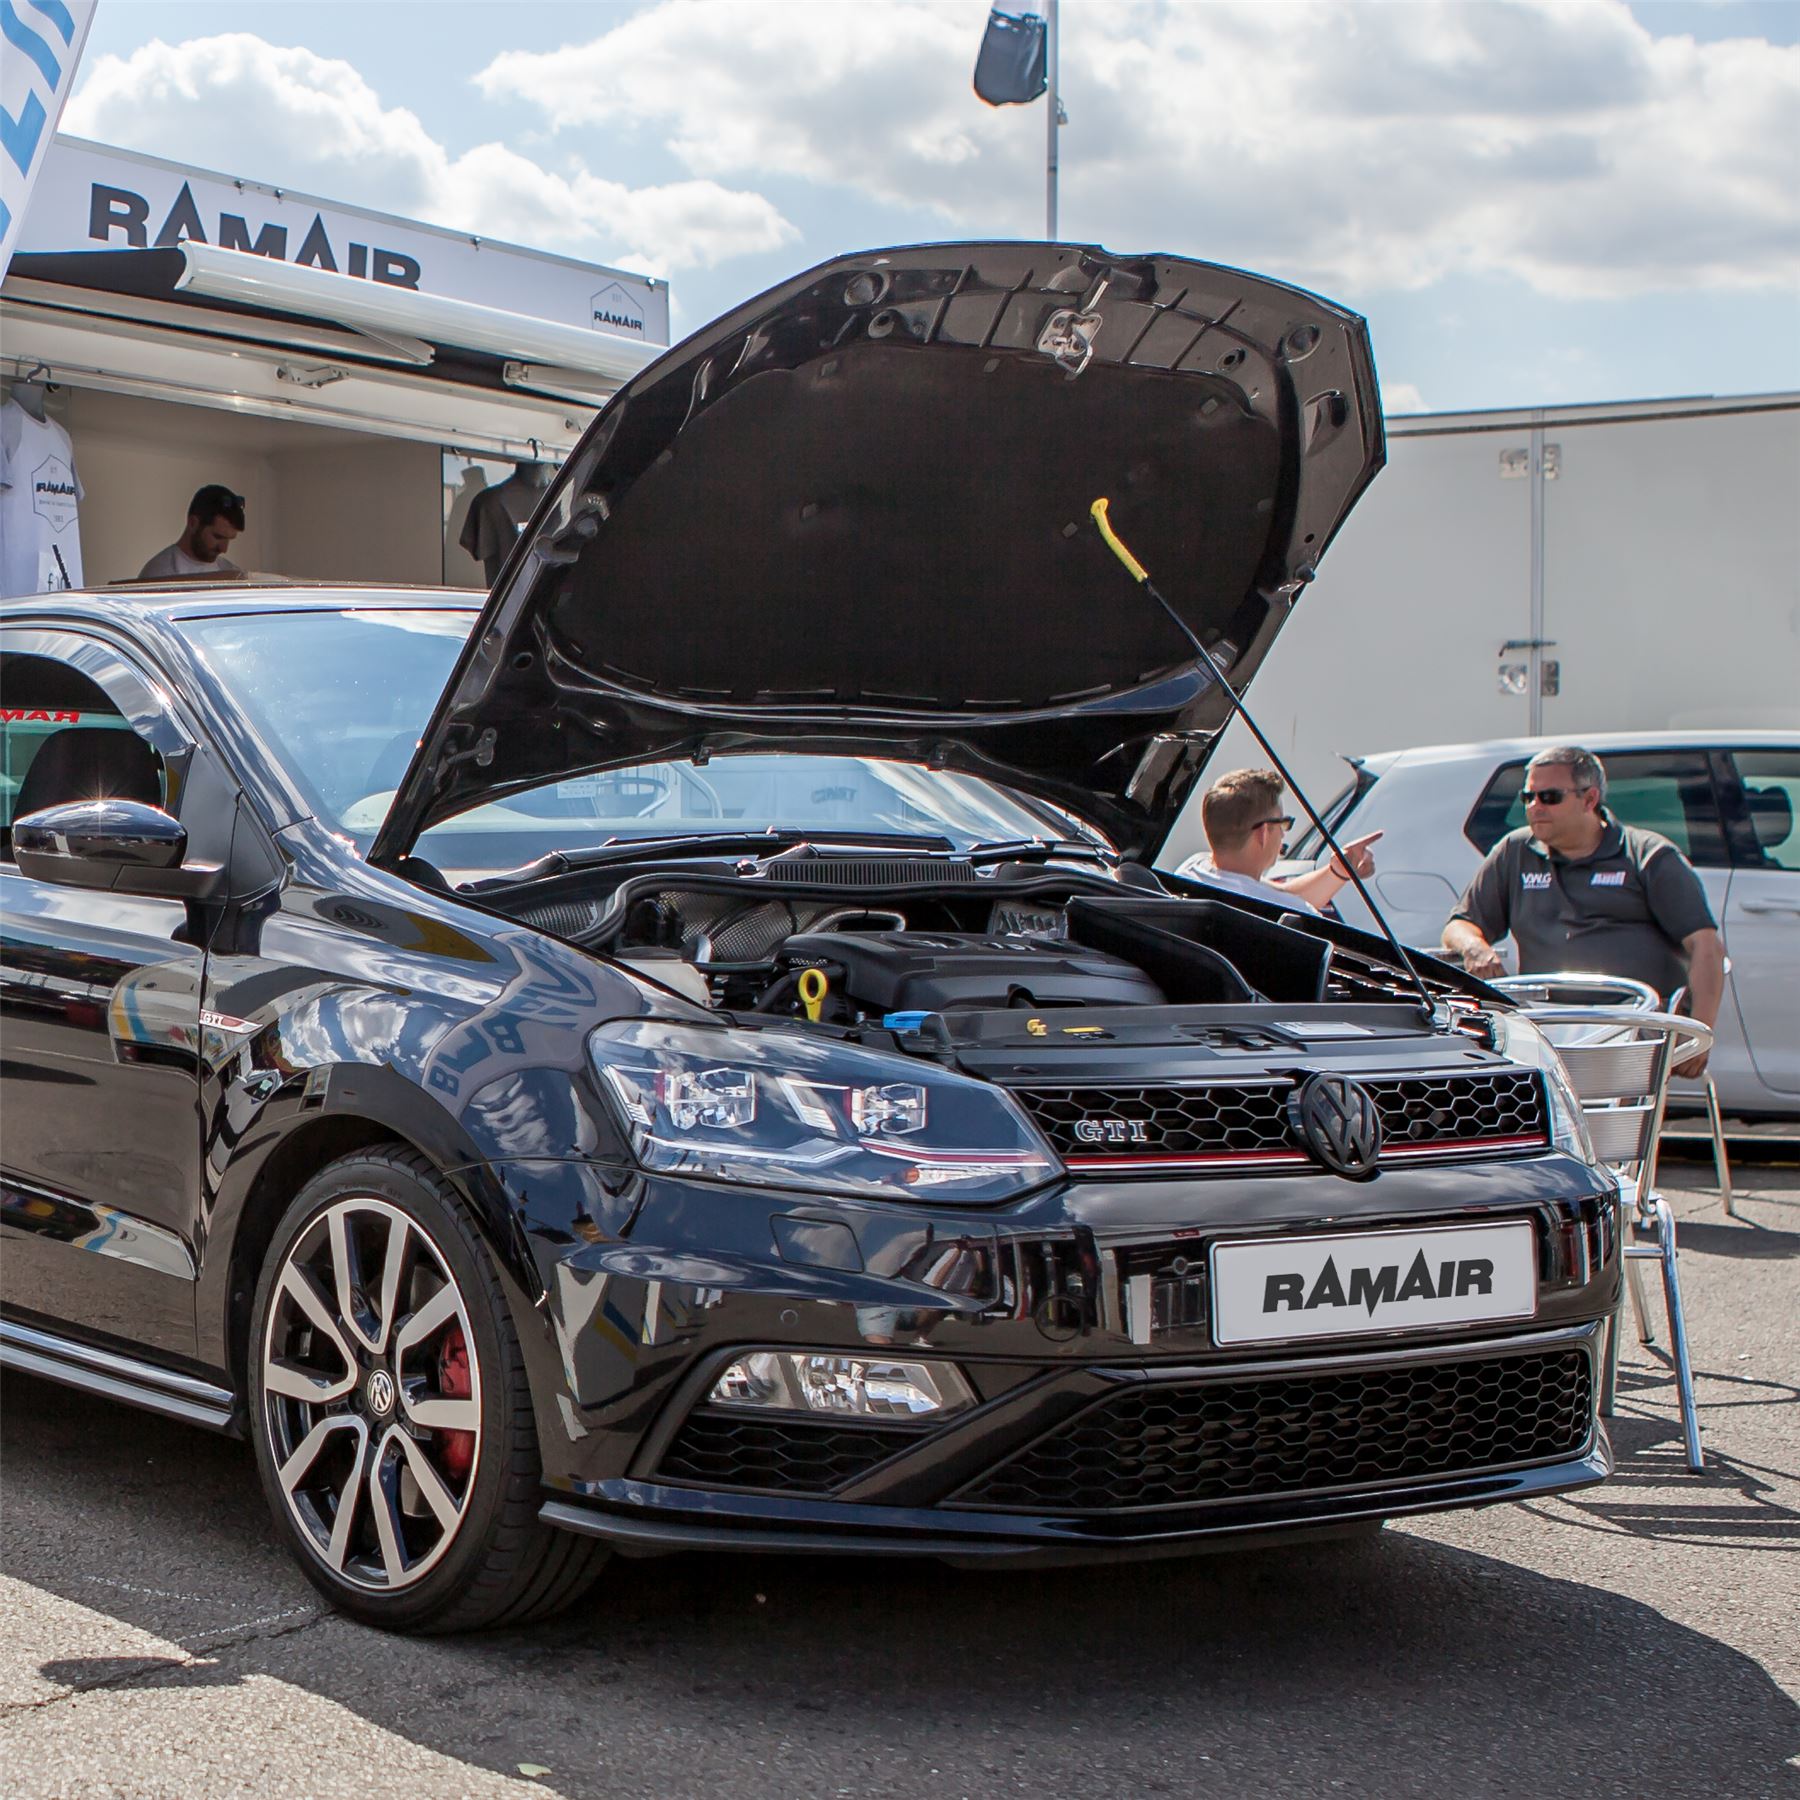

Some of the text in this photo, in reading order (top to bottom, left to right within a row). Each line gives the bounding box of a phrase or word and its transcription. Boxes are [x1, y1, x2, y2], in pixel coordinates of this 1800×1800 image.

[90, 180, 421, 291] RAMAIR
[594, 310, 642, 330] RAMAIR
[1075, 1120, 1147, 1141] GTI
[1262, 1248, 1494, 1318] RAMAIR
